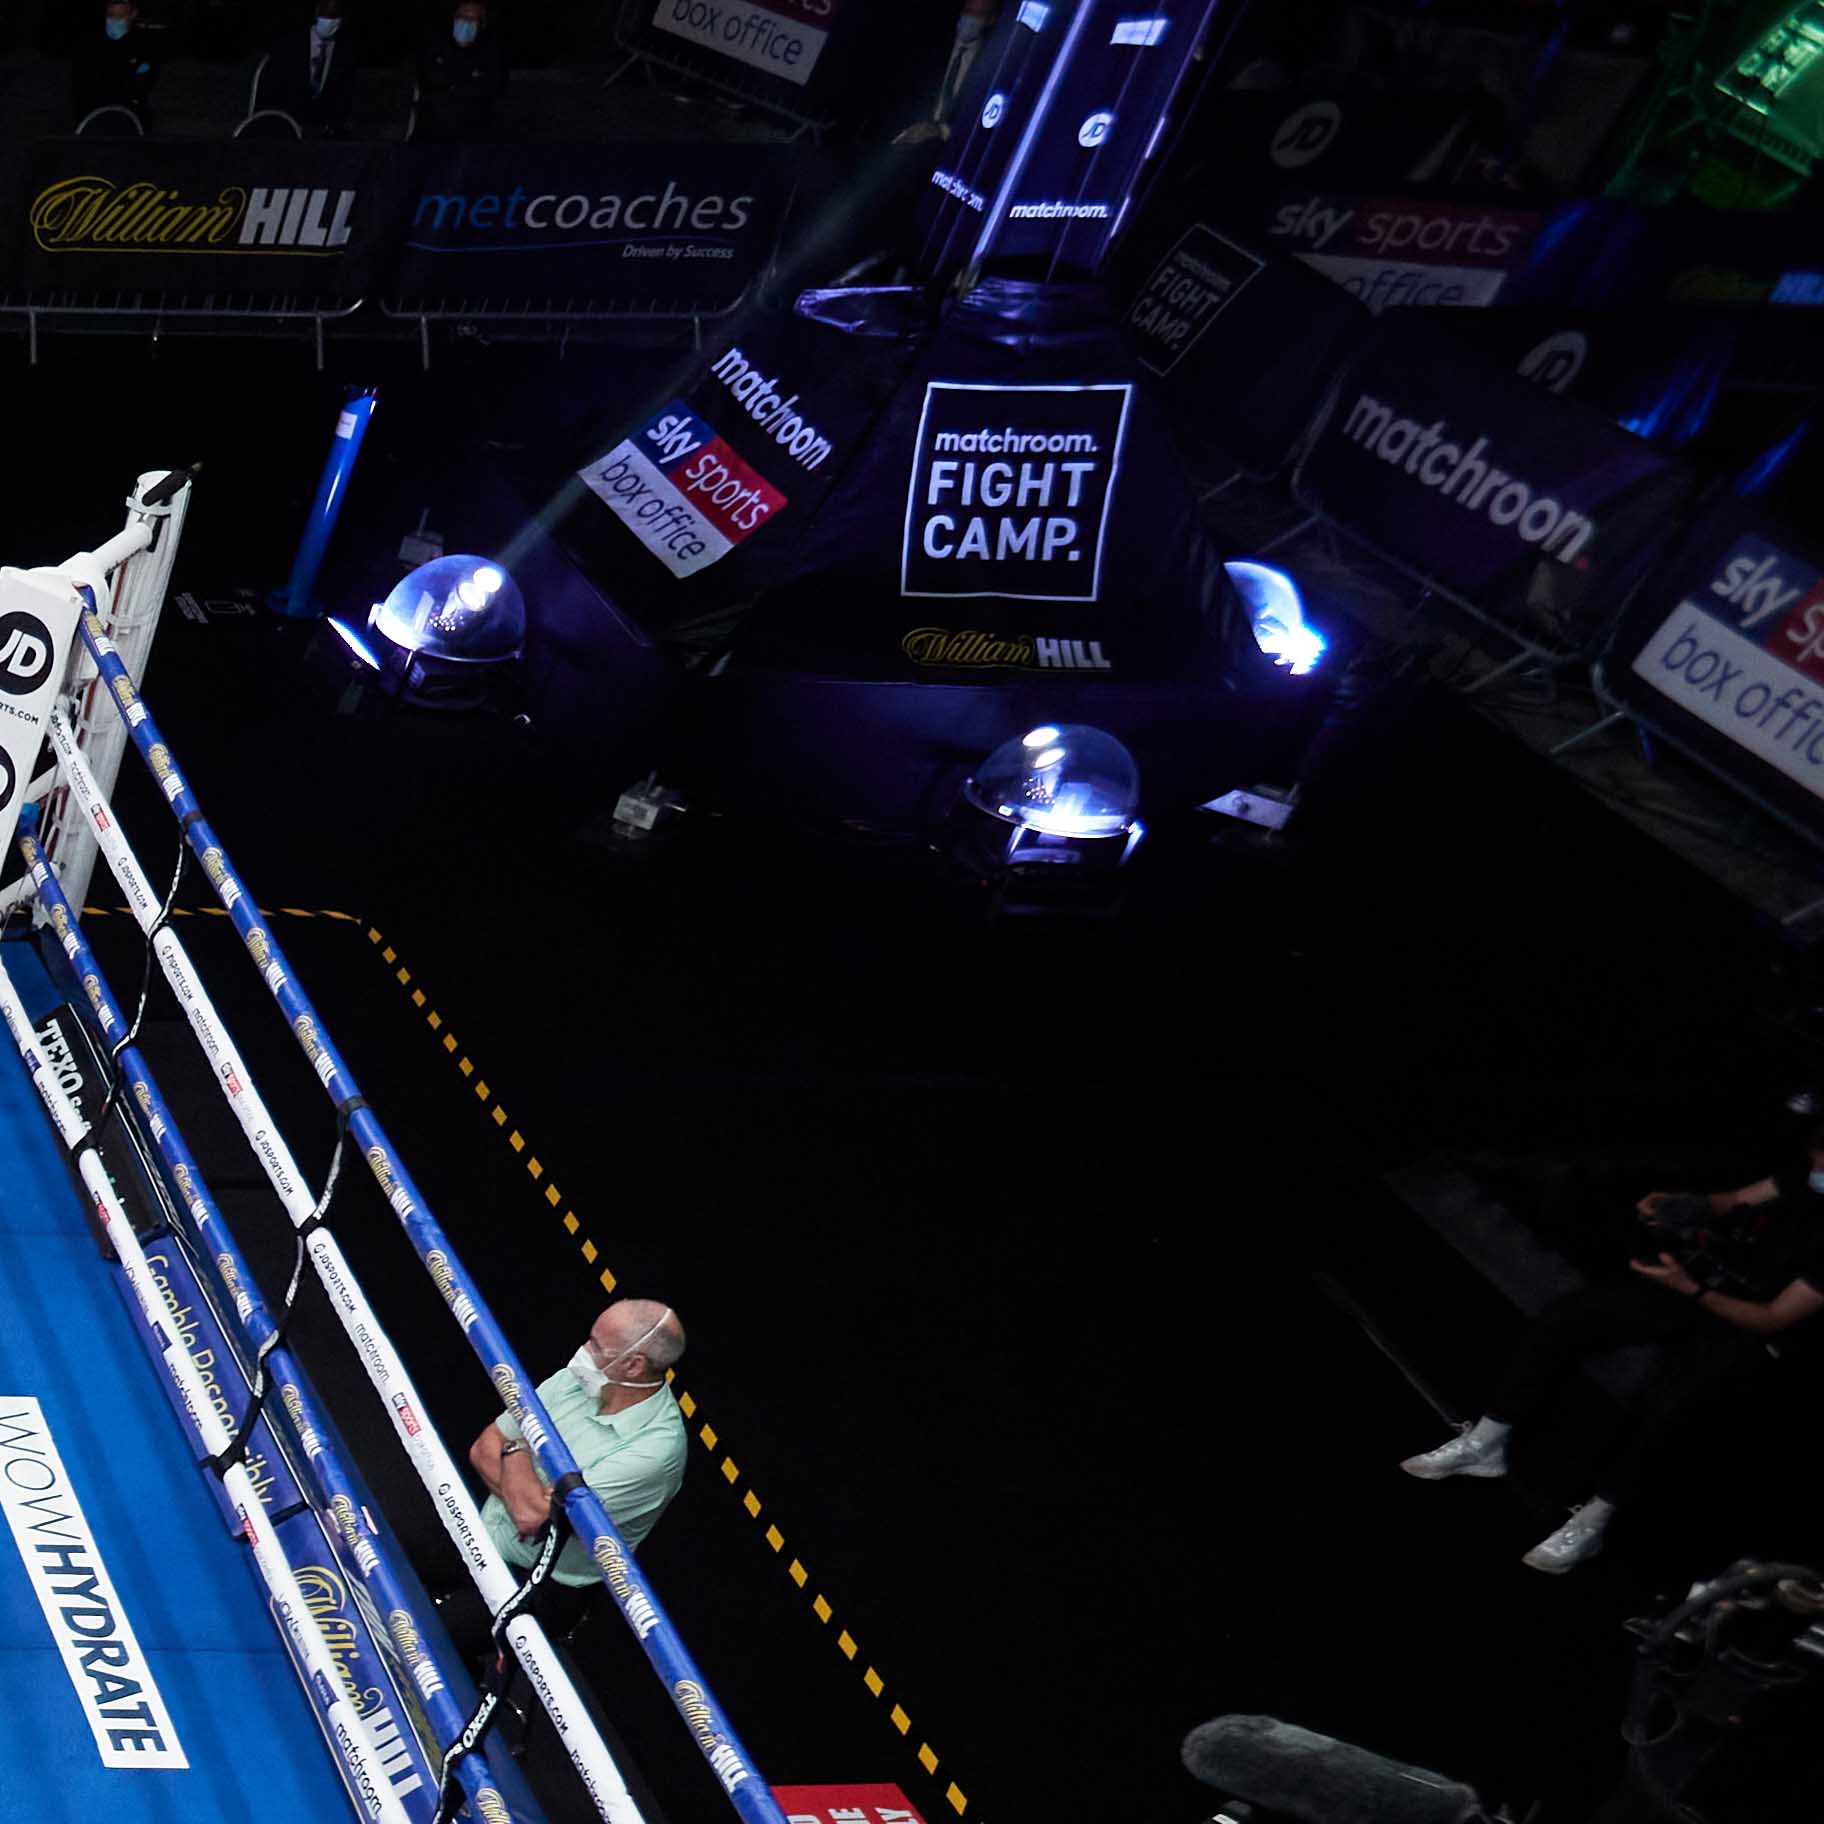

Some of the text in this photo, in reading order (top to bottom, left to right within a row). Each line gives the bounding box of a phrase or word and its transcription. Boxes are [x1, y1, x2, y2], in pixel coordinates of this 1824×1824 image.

[723, 14, 802, 65] office
[30, 175, 357, 253] William HILL
[410, 178, 755, 232] metcoaches
[1270, 195, 1521, 257] sky sports
[933, 428, 1099, 457] matchroom.
[646, 414, 770, 531] sky sports
[926, 460, 1096, 508] FIGHT
[601, 454, 706, 561] box office
[921, 515, 1082, 562] CAMP.
[1710, 554, 1800, 628] sky
[899, 626, 1112, 669] William HILL
[1660, 624, 1743, 702] box
[625, 1585, 660, 1642] HILL
